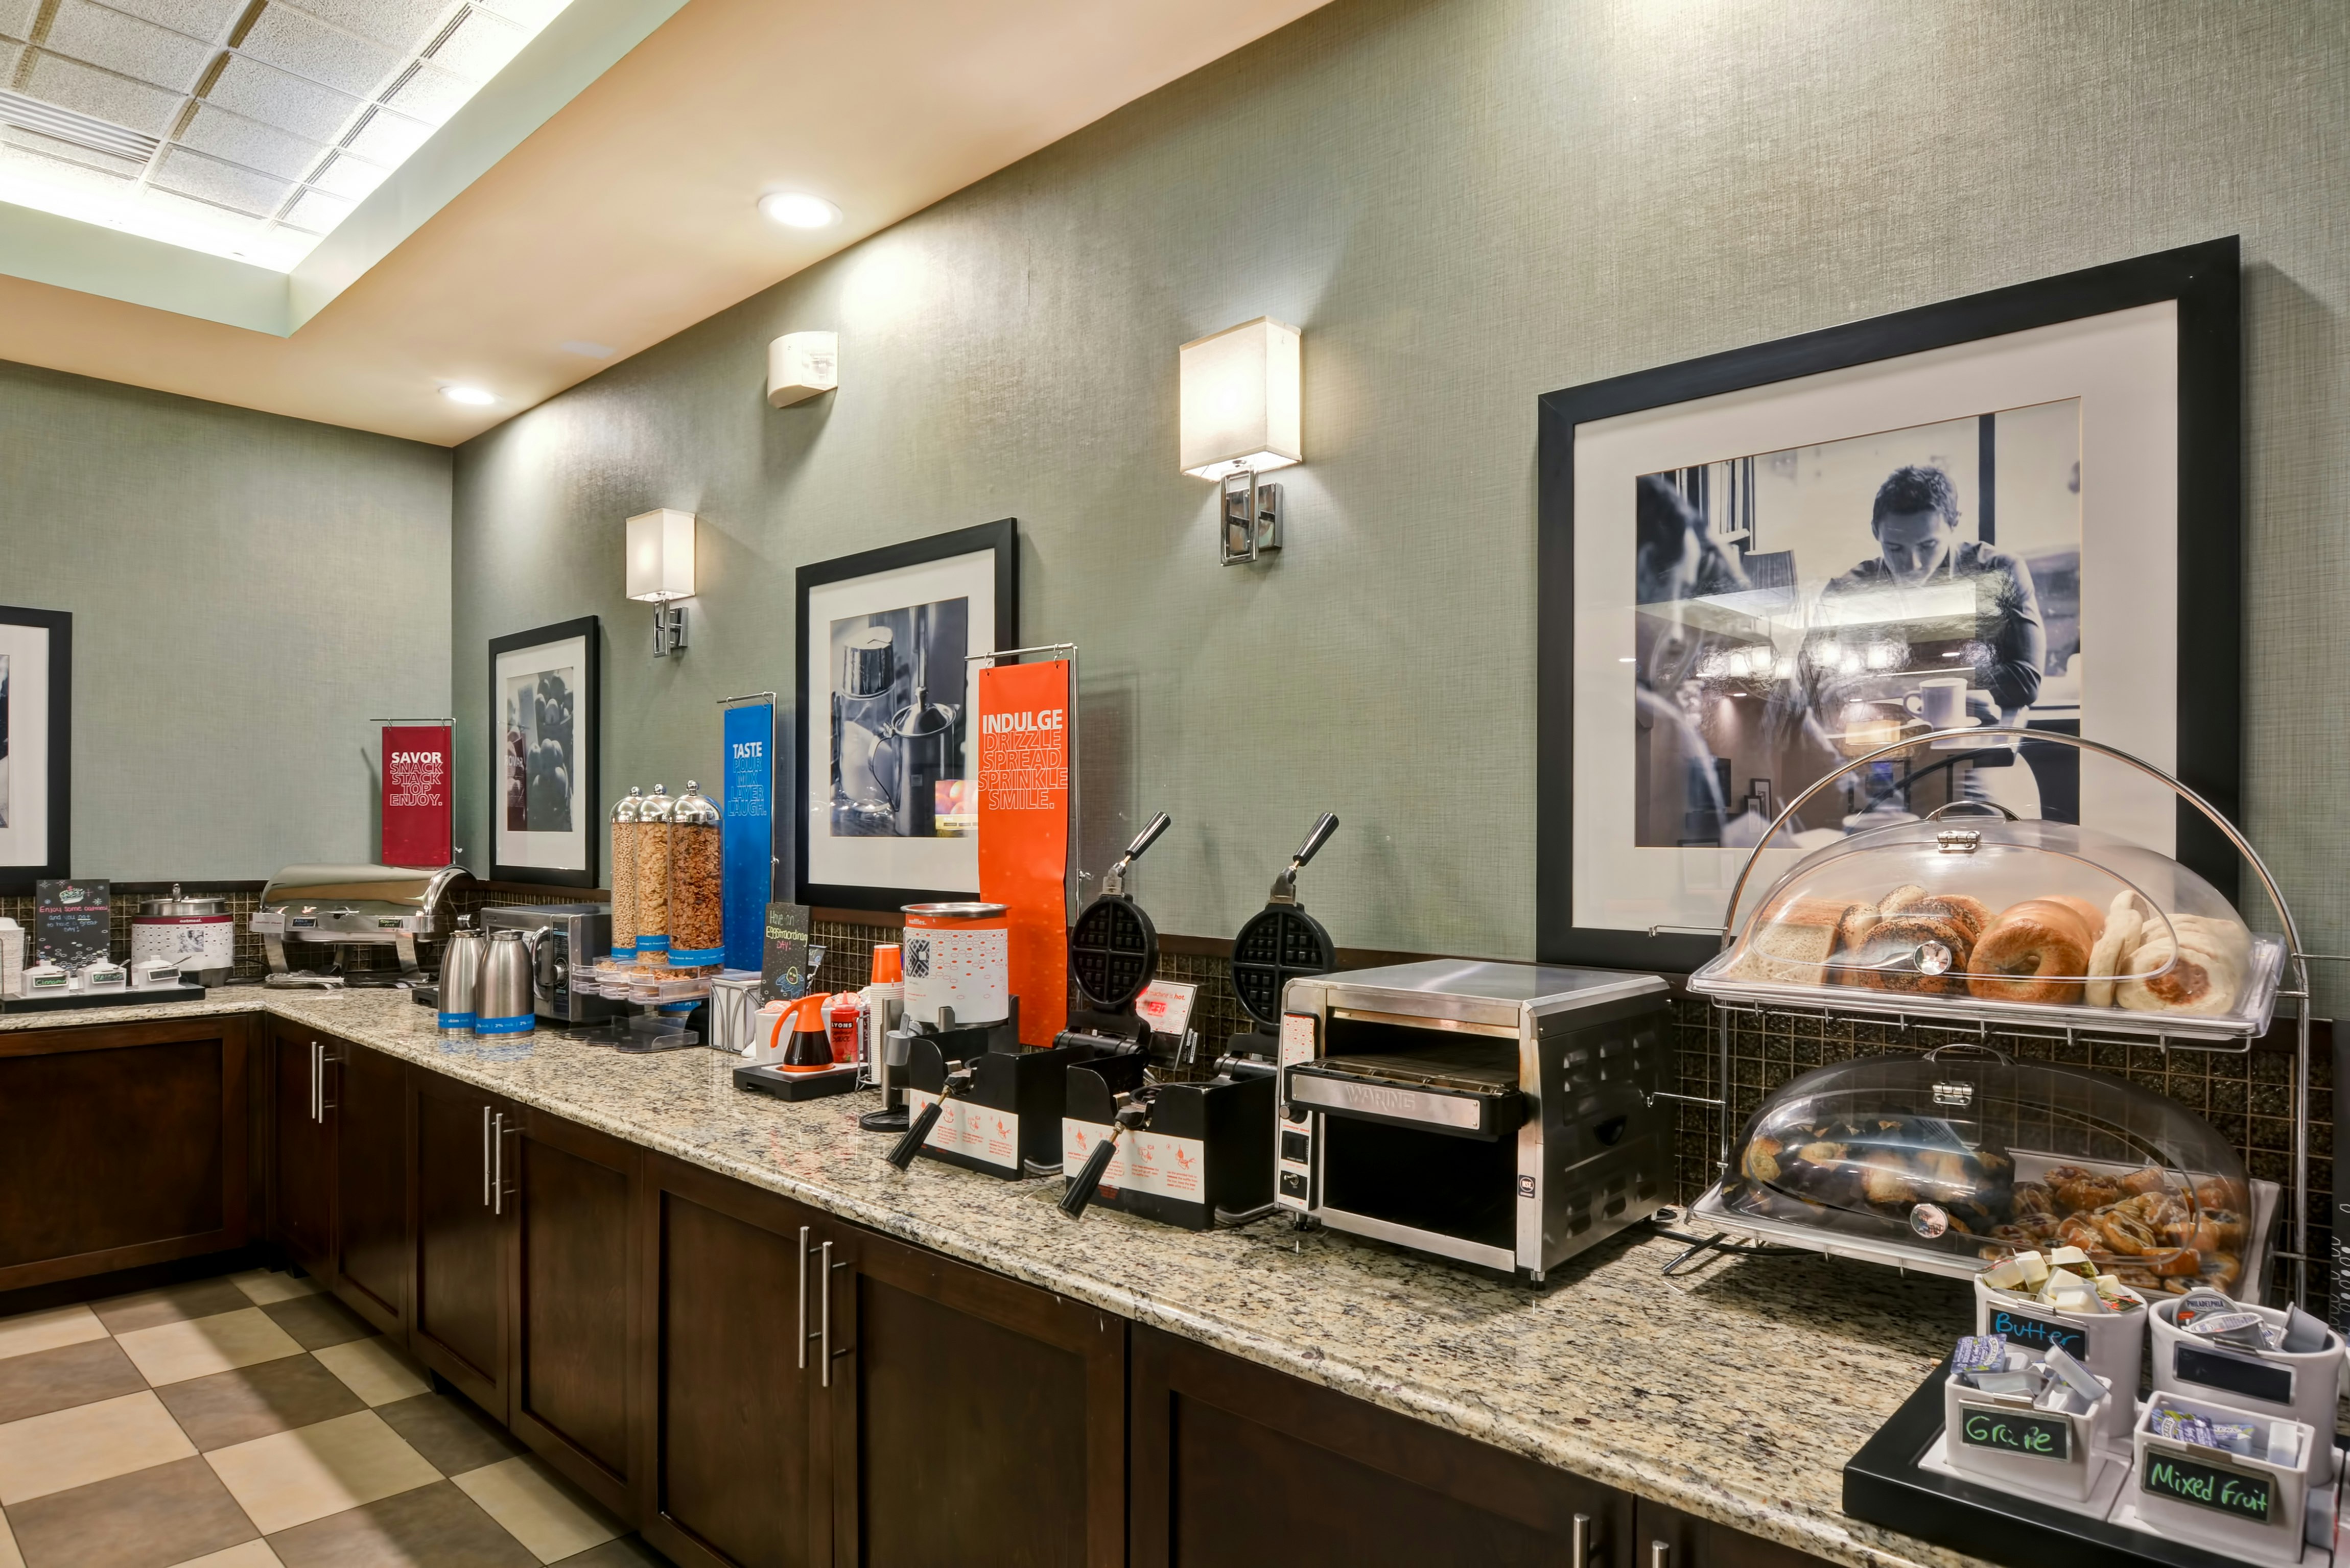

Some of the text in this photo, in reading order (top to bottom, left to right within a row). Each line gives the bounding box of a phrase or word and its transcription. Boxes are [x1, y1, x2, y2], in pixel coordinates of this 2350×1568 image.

[982, 709, 1063, 734] INDULGE
[983, 729, 1061, 752] DRIZZLE
[391, 752, 442, 764] SAVOR
[733, 742, 762, 758] TASTE
[390, 762, 443, 774] SNACK
[733, 757, 762, 773] POUR
[983, 749, 1062, 772] SPREAD
[392, 773, 441, 785] STACK
[736, 771, 758, 786] MIX
[978, 767, 1068, 791] SPRINKLE
[402, 783, 432, 795] TOP
[731, 785, 764, 800] LAYER
[390, 794, 442, 806] ENJOY.
[989, 789, 1054, 810] SMILE.
[728, 800, 767, 816] LAUGH.
[1346, 1085, 1416, 1111] WARING
[1995, 1313, 2080, 1346] Butter
[2151, 1463, 2267, 1511] Mixed Fruit
